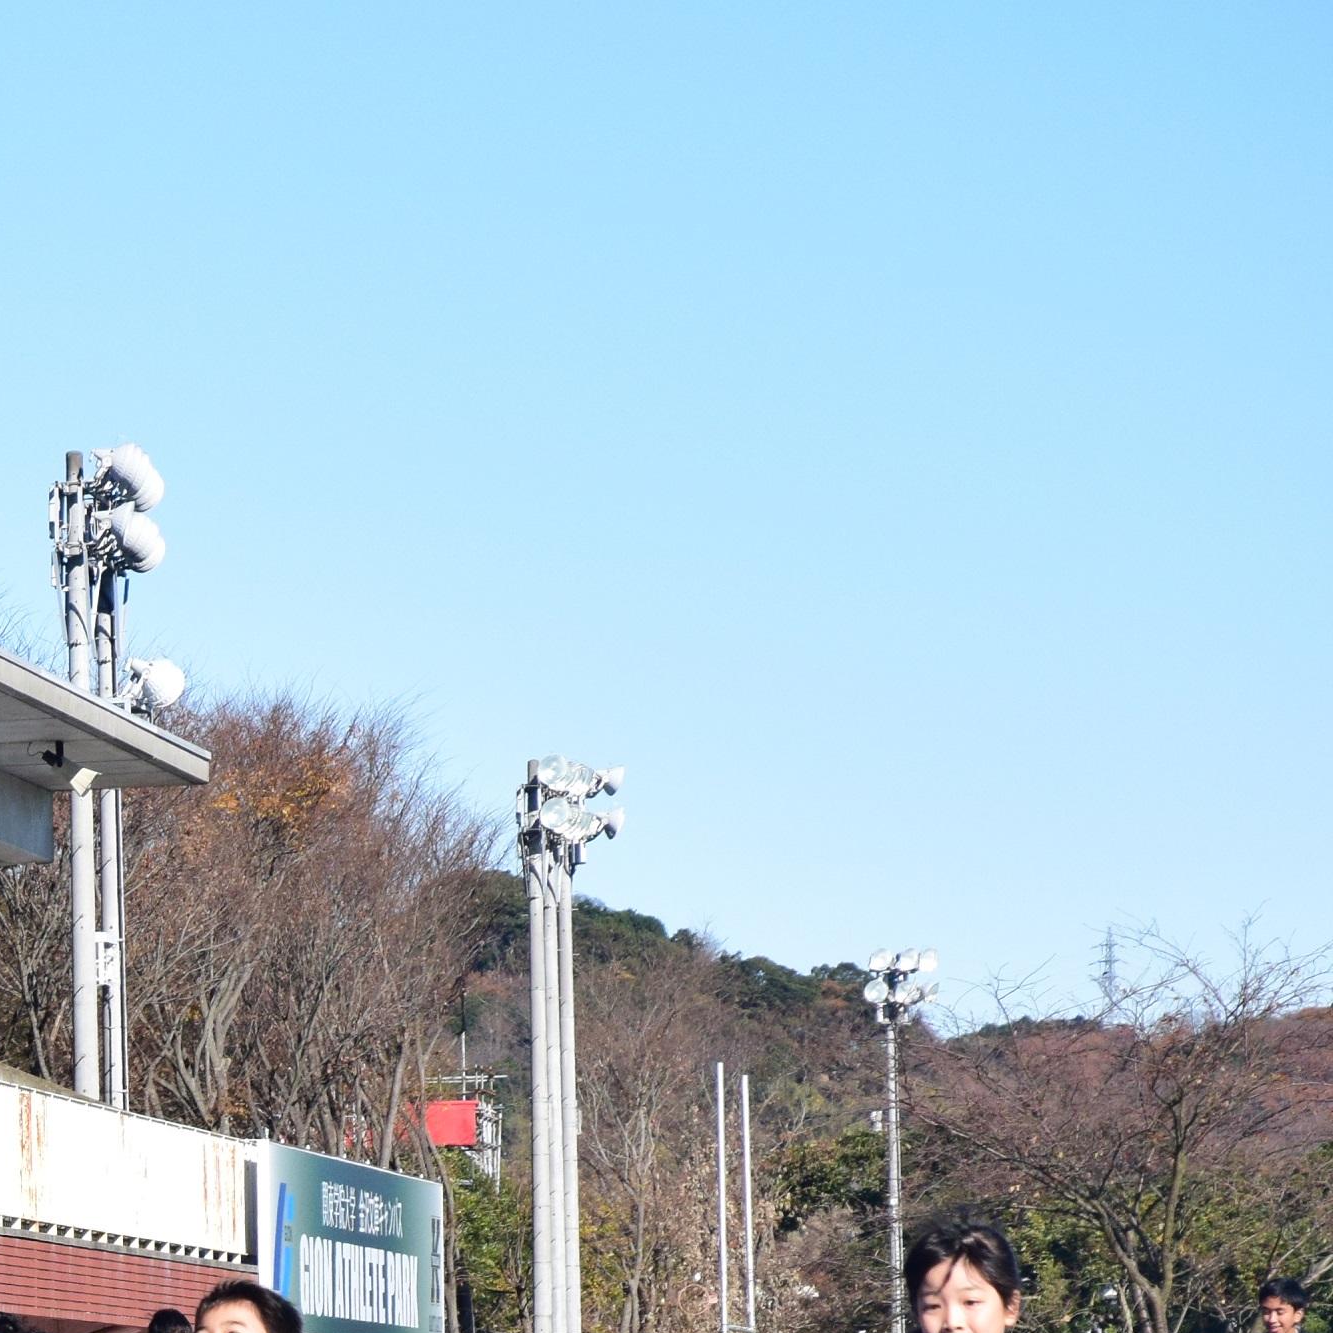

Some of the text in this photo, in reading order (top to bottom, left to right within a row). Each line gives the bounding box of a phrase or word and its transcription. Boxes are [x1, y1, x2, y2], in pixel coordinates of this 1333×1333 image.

[299, 1233, 419, 1329] GION ATHLETE PARK
